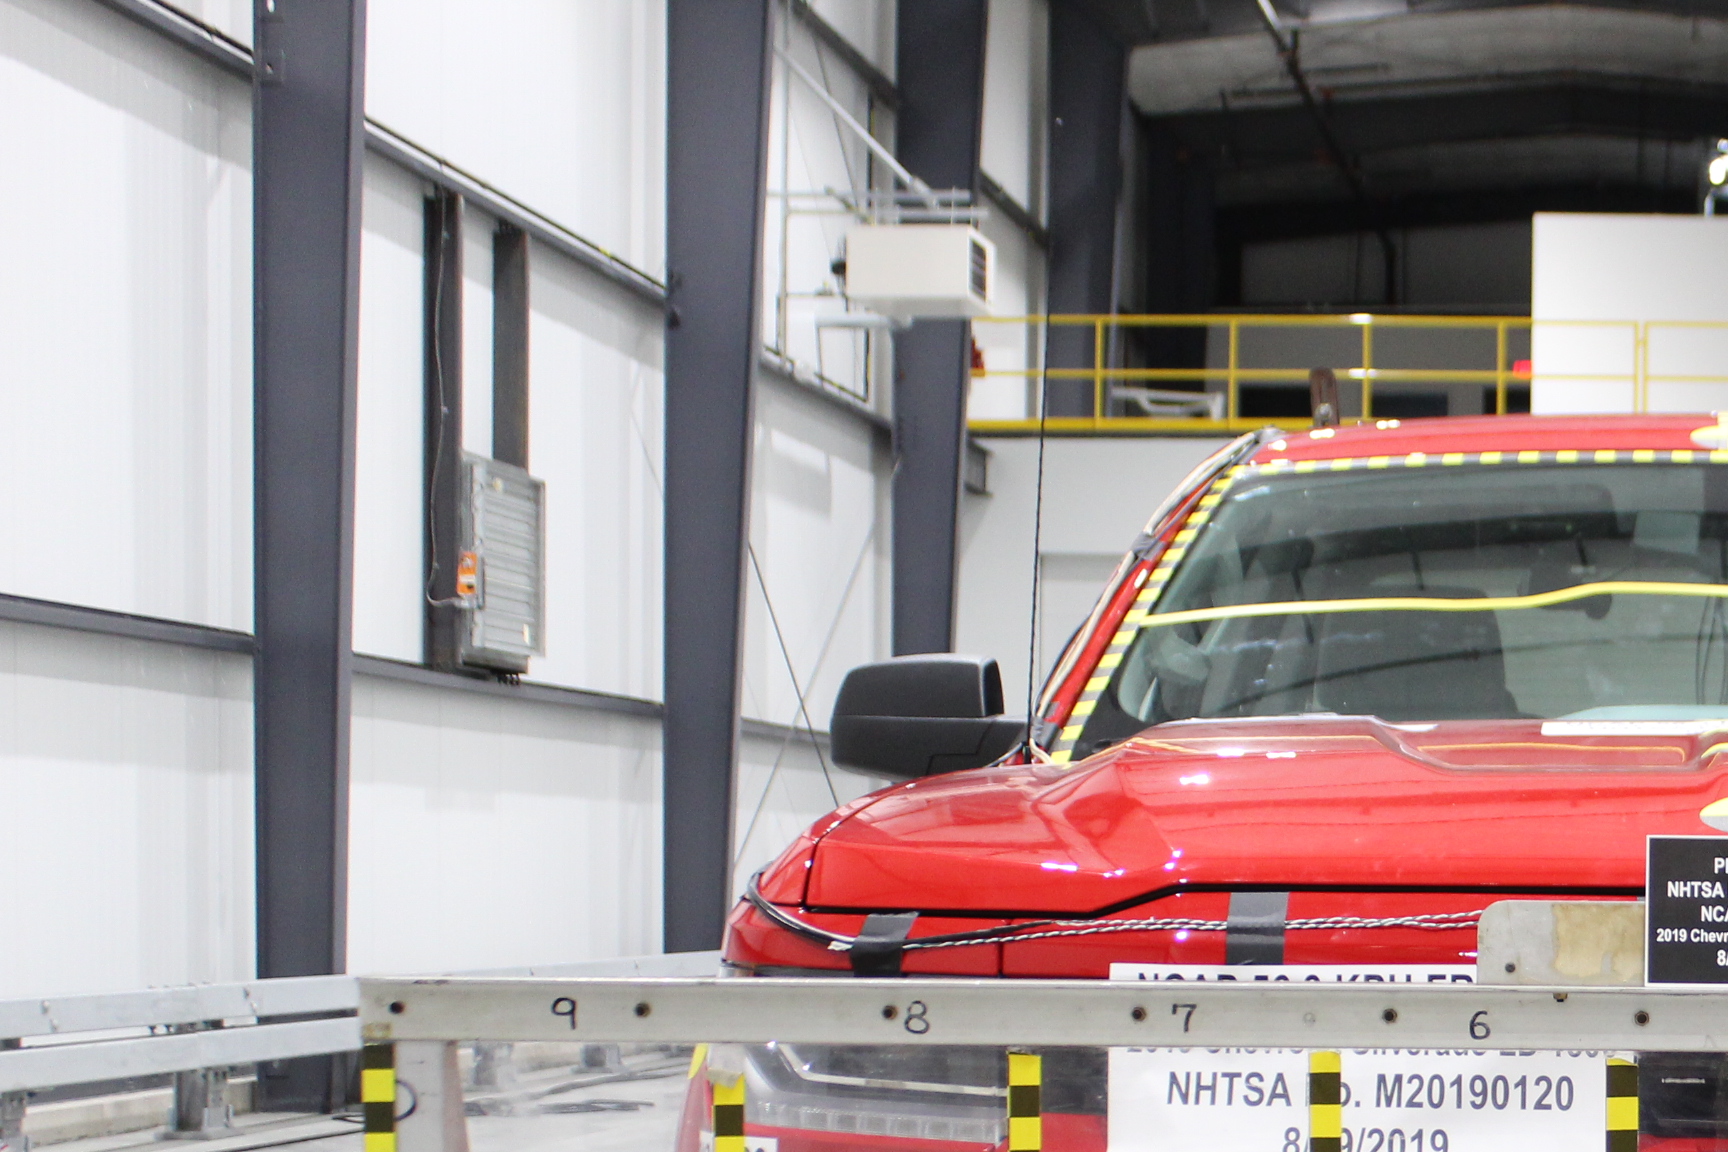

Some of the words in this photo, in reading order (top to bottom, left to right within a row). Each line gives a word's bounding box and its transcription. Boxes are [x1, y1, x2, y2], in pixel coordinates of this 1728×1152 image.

[1667, 881, 1724, 898] NHTSA
[1656, 928, 1687, 942] 2019
[551, 997, 577, 1030] 9
[904, 1000, 930, 1035] 8
[1171, 1003, 1197, 1033] 7
[1468, 1010, 1491, 1040] 6
[1166, 1071, 1293, 1107] NHTSA
[1375, 1073, 1574, 1111] M20190120
